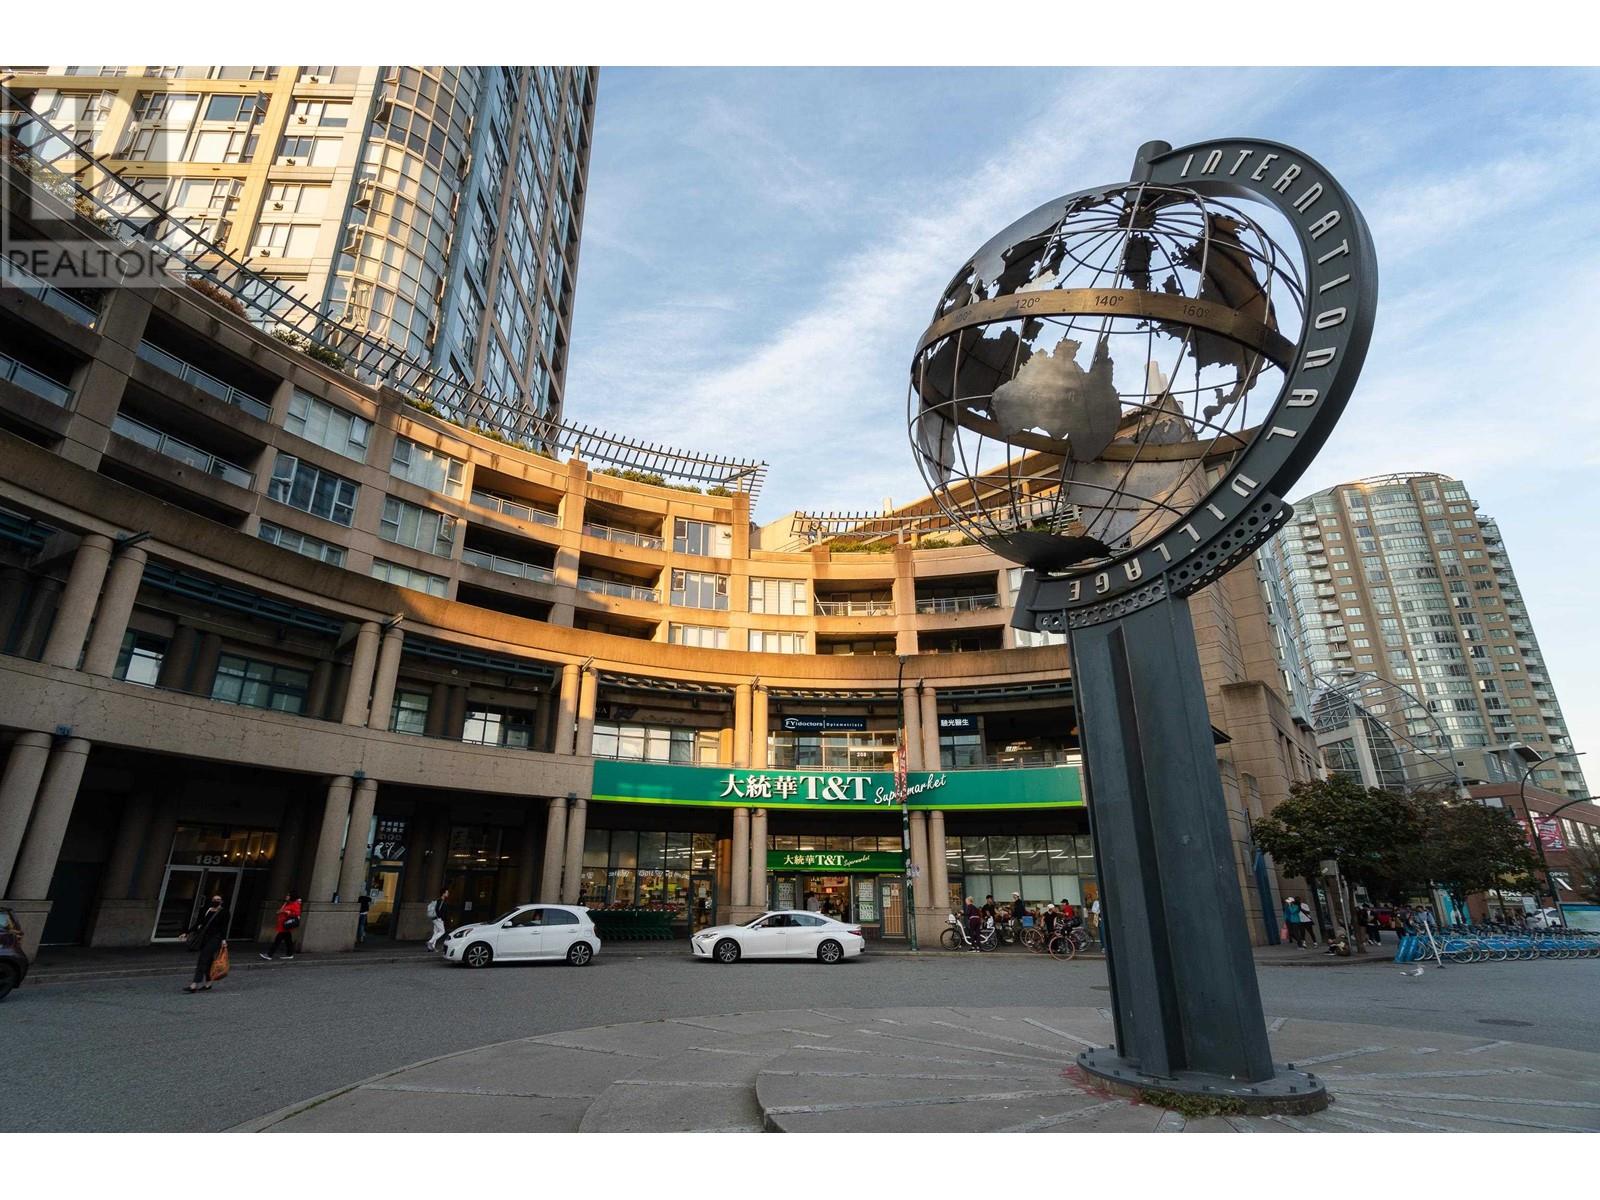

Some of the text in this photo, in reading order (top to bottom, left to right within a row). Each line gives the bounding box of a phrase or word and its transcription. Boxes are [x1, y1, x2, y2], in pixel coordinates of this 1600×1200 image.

[1181, 149, 1350, 440] INTERNATIONAL
[719, 773, 798, 799] 大統華
[799, 776, 872, 801] T&T
[874, 773, 947, 807] Supmarket
[815, 854, 845, 866] T&T
